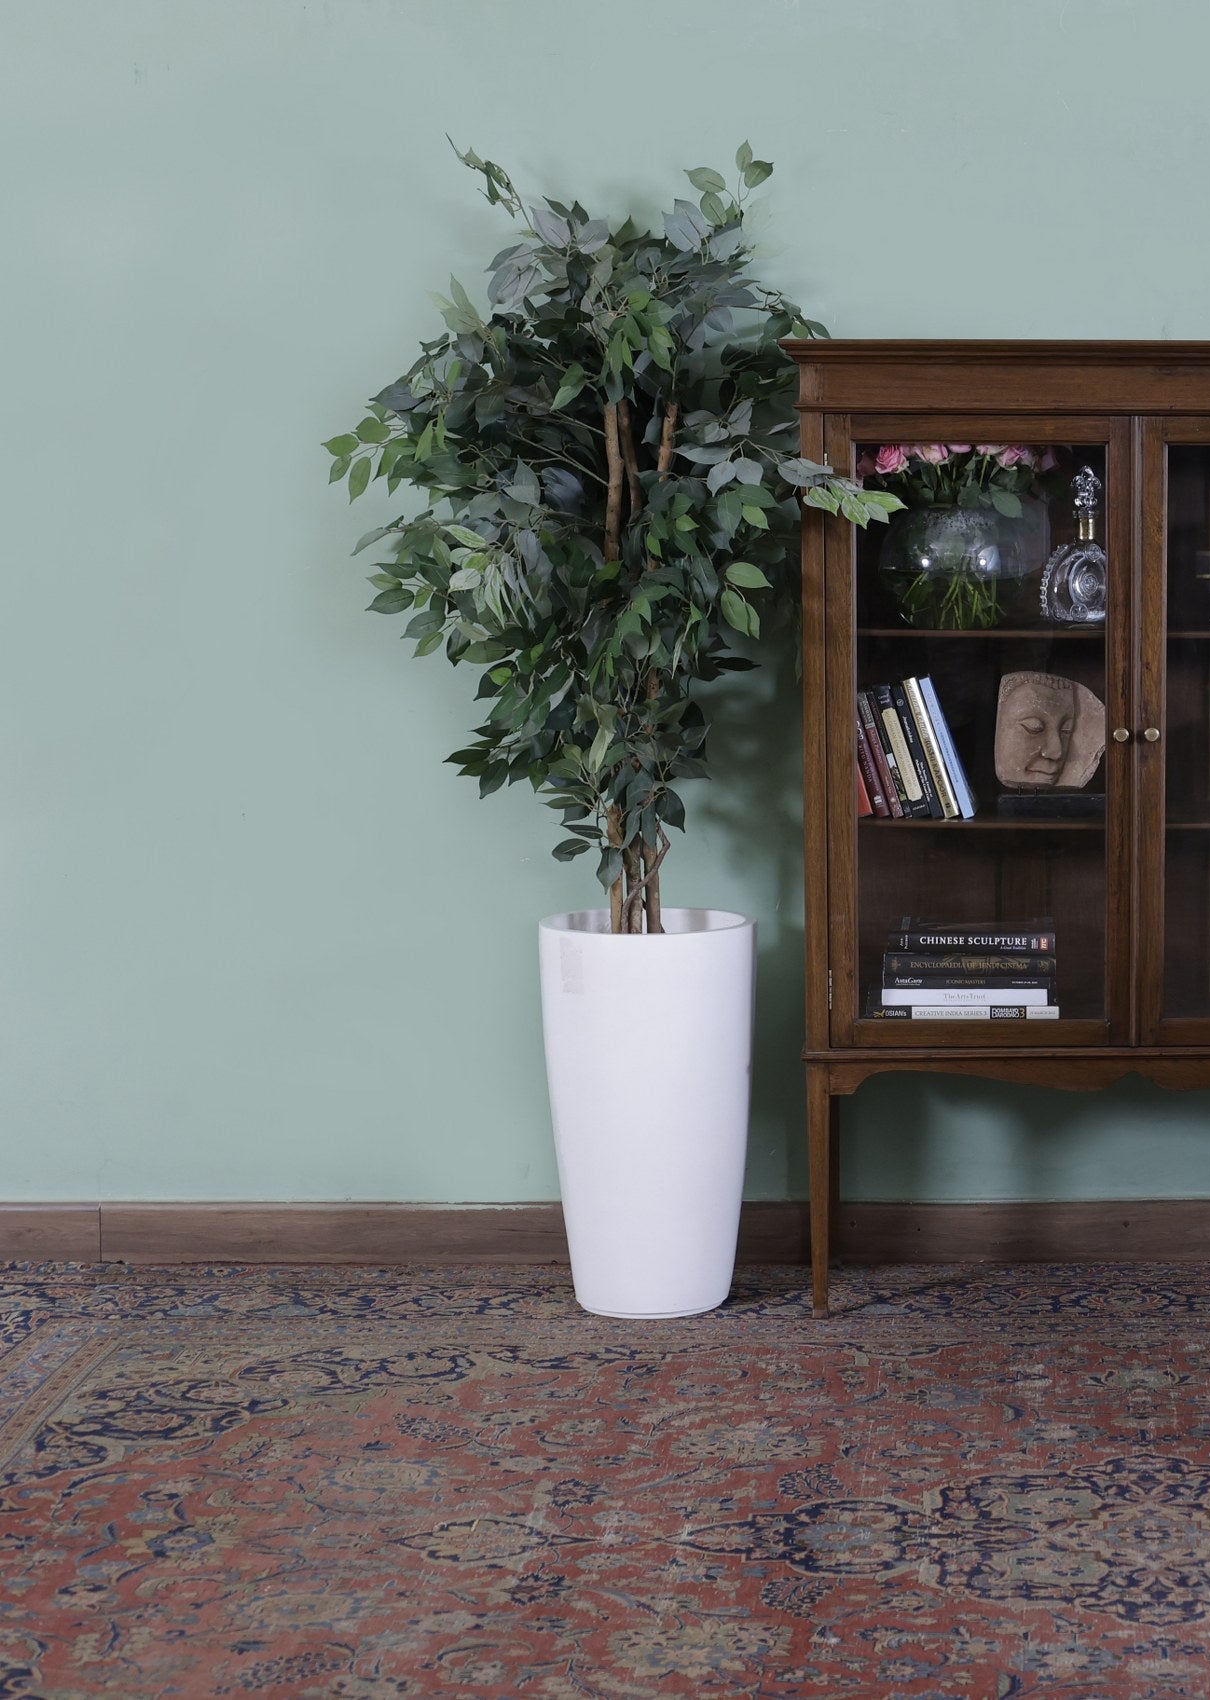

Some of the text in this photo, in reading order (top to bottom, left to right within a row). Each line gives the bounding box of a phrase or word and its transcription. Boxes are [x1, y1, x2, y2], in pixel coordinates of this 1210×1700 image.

[862, 761, 872, 782] NANDA
[934, 762, 947, 799] KAPOOR
[920, 936, 965, 945] CHINESE
[968, 936, 1027, 946] SCULPTURE
